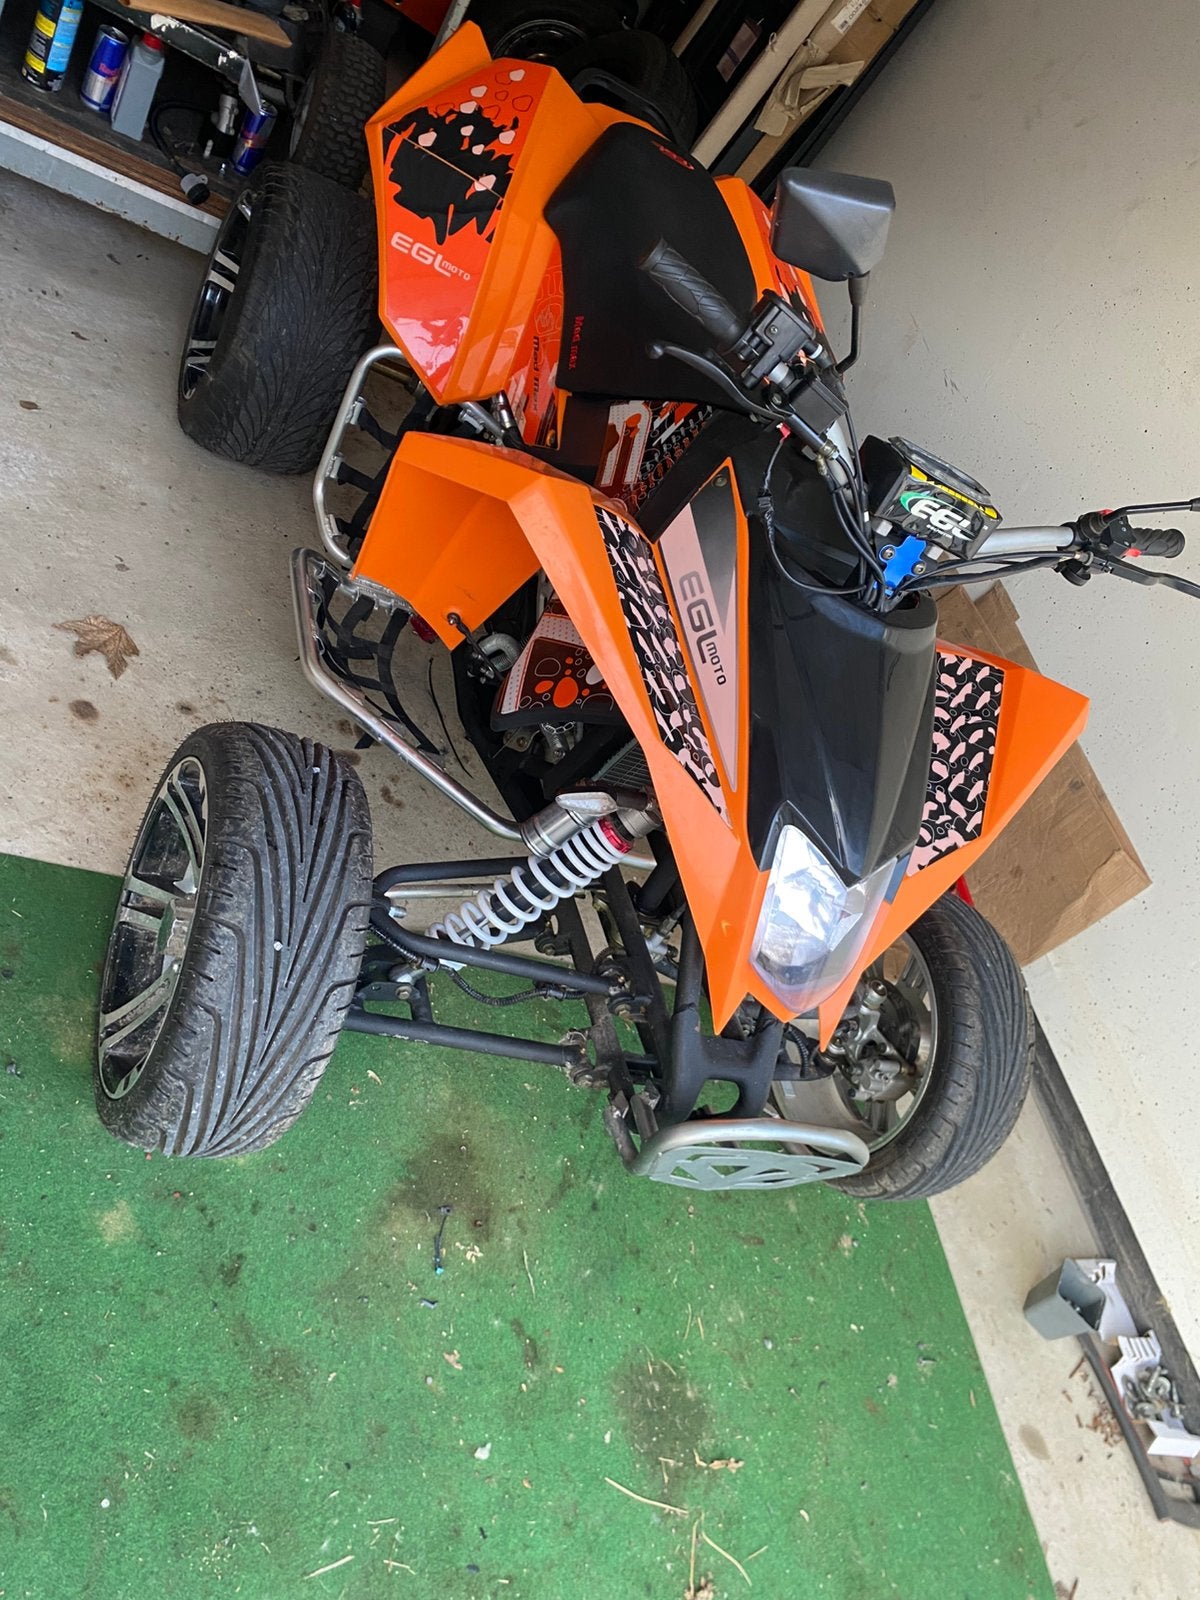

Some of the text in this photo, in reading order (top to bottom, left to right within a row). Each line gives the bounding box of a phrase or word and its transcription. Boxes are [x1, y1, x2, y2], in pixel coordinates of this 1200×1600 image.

[390, 231, 452, 278] EGL
[909, 498, 973, 541] EGL
[679, 570, 727, 686] EGL MOTO
